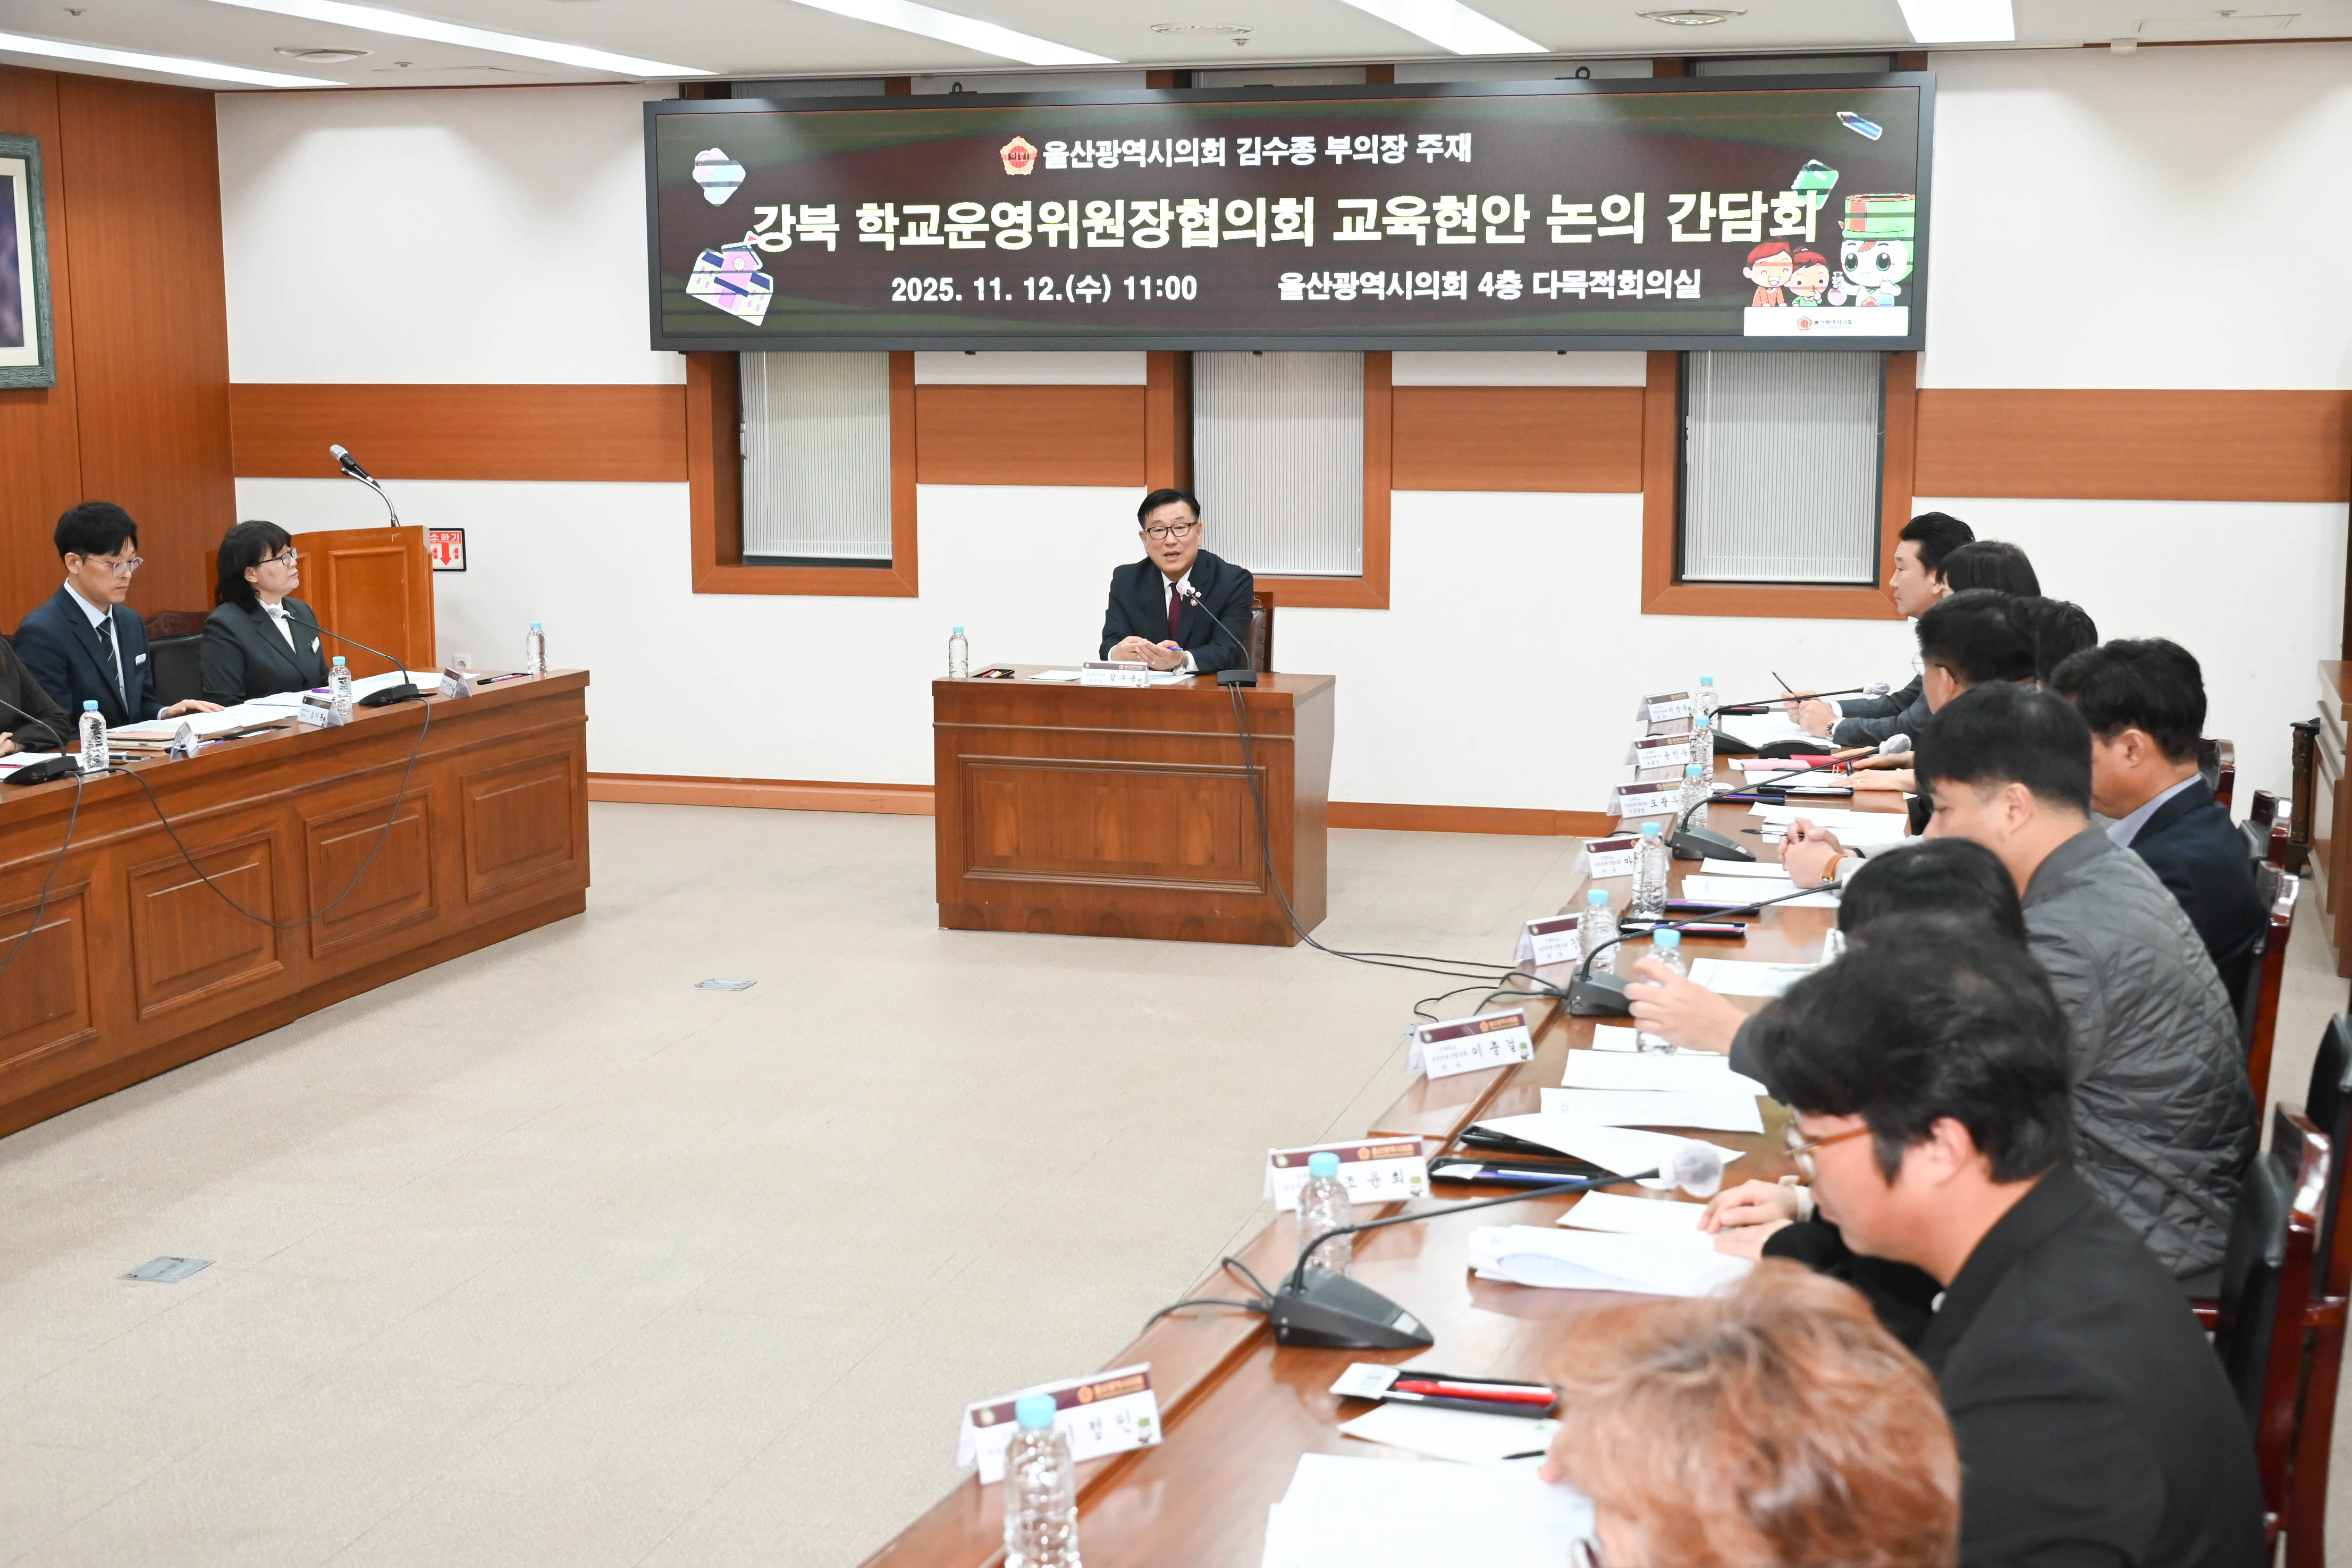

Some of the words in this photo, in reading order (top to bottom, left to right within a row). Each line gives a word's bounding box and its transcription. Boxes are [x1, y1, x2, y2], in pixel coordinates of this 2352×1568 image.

[1043, 137, 1226, 169] 울산광역시의회
[1236, 136, 1317, 166] 김수종
[1325, 134, 1408, 165] 부의장
[1416, 132, 1472, 163] 주재
[753, 204, 840, 252] 강북
[856, 197, 1314, 251] 학교운영위원장협의회
[1333, 193, 1531, 246] 교육현안
[1546, 192, 1645, 244] 논의
[1667, 190, 1818, 243] 간담회
[892, 277, 962, 301] 2025.
[973, 277, 1012, 301] 11.
[1023, 274, 1111, 304] 12.(수)
[1124, 275, 1197, 300] 11:00
[1278, 270, 1467, 301] 울산광역시의회
[1478, 269, 1523, 300] 4층
[1532, 269, 1701, 300] 다목적회의실
